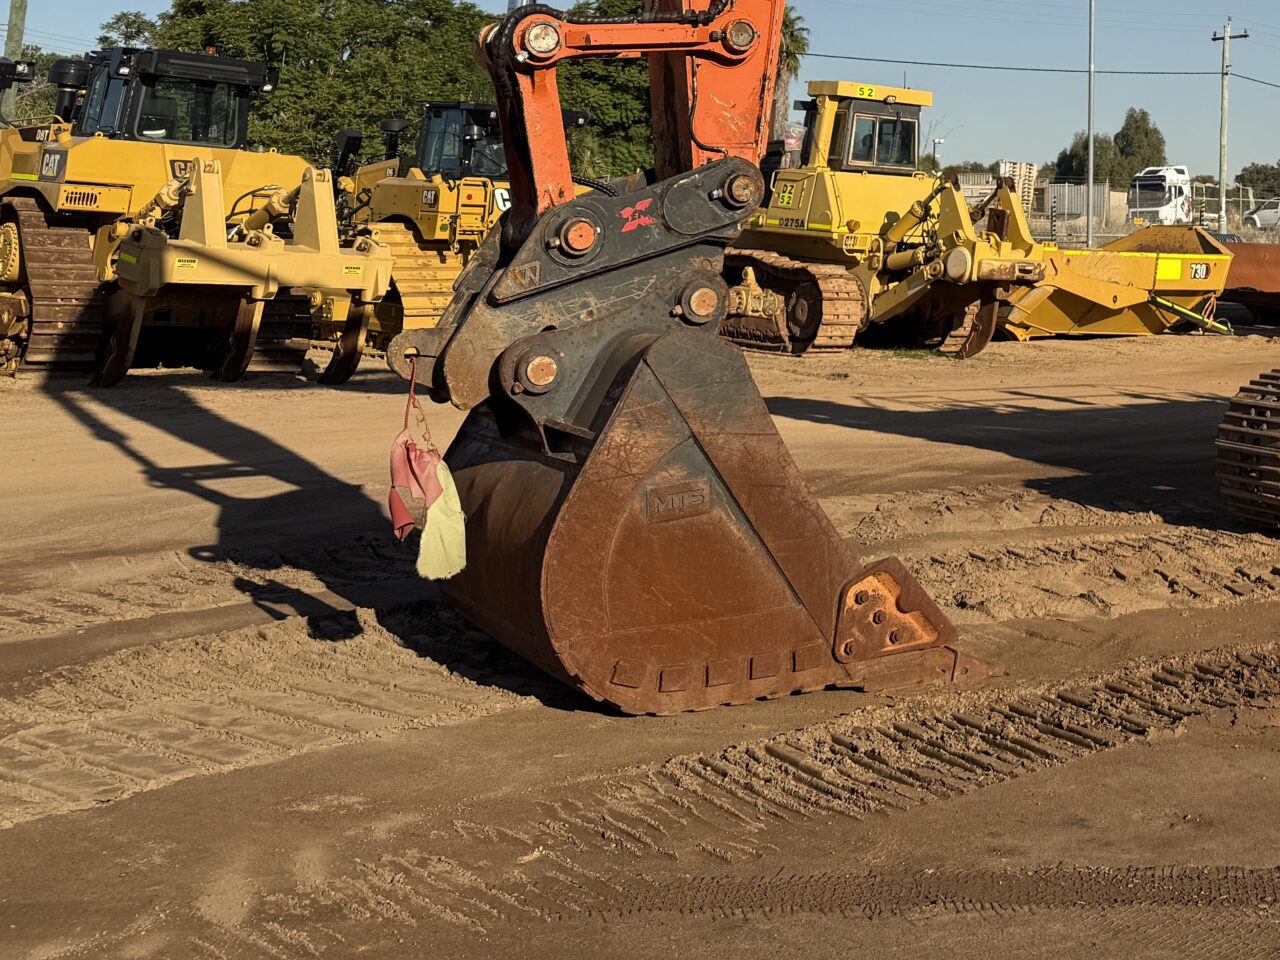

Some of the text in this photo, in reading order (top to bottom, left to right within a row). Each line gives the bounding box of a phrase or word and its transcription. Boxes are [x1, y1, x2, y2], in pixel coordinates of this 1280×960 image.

[42, 153, 61, 177] CAT
[174, 161, 195, 178] CA
[422, 190, 436, 205] CAT
[1189, 263, 1208, 280] 730
